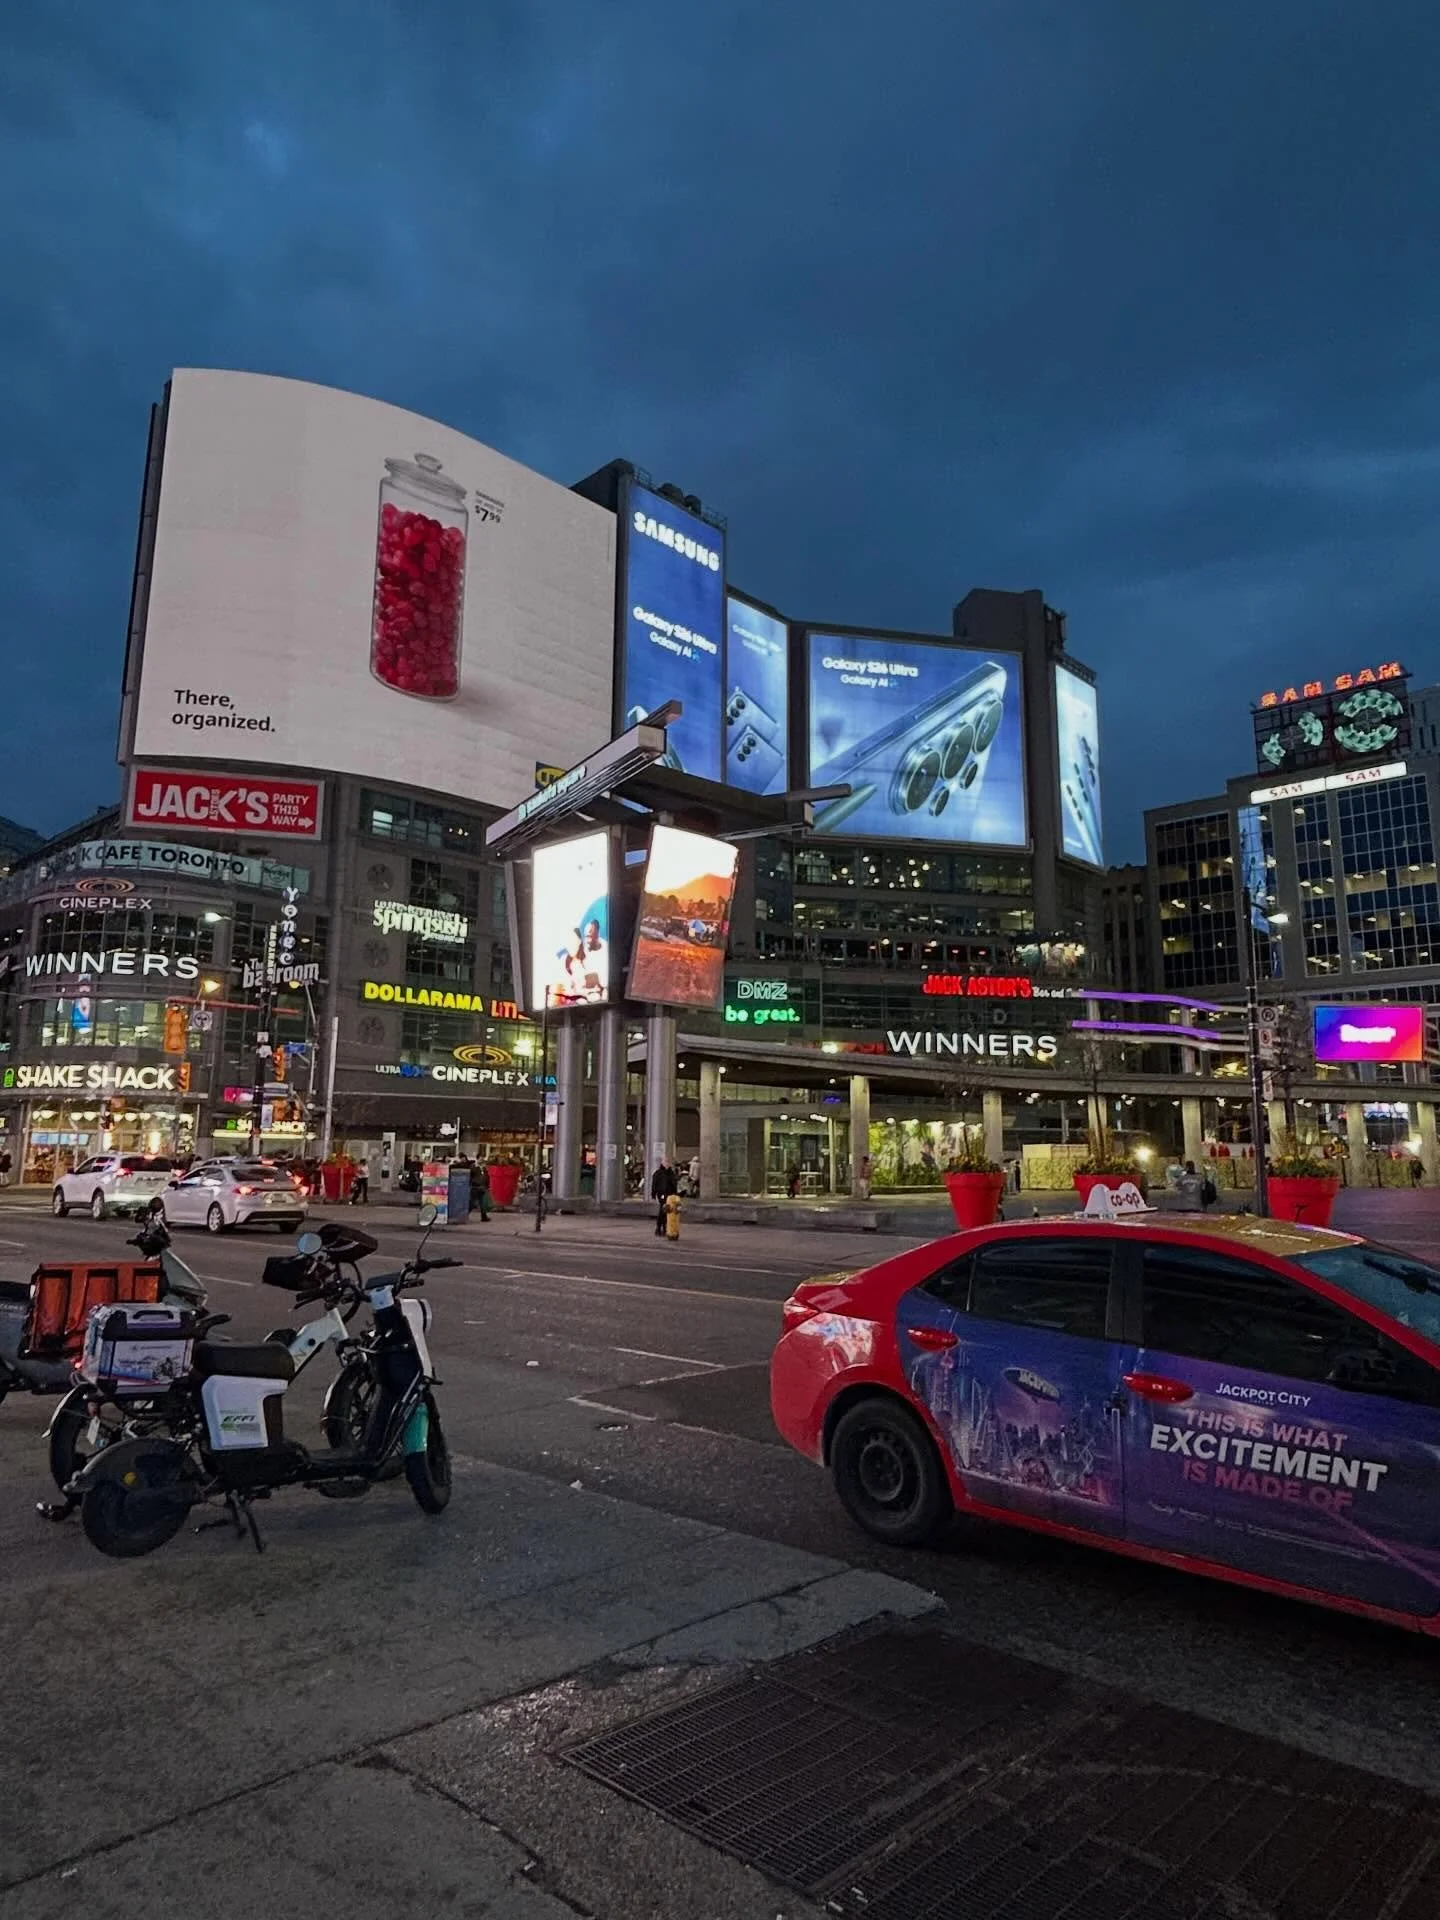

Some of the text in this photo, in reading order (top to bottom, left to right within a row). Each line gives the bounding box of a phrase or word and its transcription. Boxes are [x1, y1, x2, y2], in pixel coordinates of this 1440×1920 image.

[634, 511, 720, 571] SAMSUNG
[822, 657, 867, 674] Galaxy
[888, 663, 919, 677] Ultra
[1335, 661, 1402, 690] SAM
[840, 674, 889, 689] Galaxy AI
[174, 690, 236, 710] There,
[172, 710, 276, 732] organized.
[1345, 769, 1382, 782] SAM
[272, 793, 310, 805] PARTY
[1269, 784, 1303, 797] SAM
[138, 783, 269, 824] JACK'S
[273, 804, 300, 815] THIS
[272, 815, 298, 825] WAY
[149, 847, 245, 875] TORONTO
[60, 897, 152, 910] CINEPLEX
[26, 951, 199, 979] WINNERS
[364, 981, 484, 1012] DOLLARAMA
[738, 981, 788, 1000] DMZ
[923, 975, 963, 994] JACK
[967, 976, 1032, 997] ASTOR'S
[725, 1005, 800, 1024] be great.
[887, 1031, 1058, 1057] WINNERS
[17, 1065, 177, 1091] SHAKE SHACK
[432, 1065, 529, 1086] CINEPLEX
[1111, 1192, 1139, 1208] co-op
[1216, 1383, 1276, 1402] JACKPOT
[1185, 1408, 1348, 1452] THIS IS WHAT
[1151, 1424, 1388, 1493] EXCITEMENT
[1183, 1460, 1353, 1514] IS MADE OF
